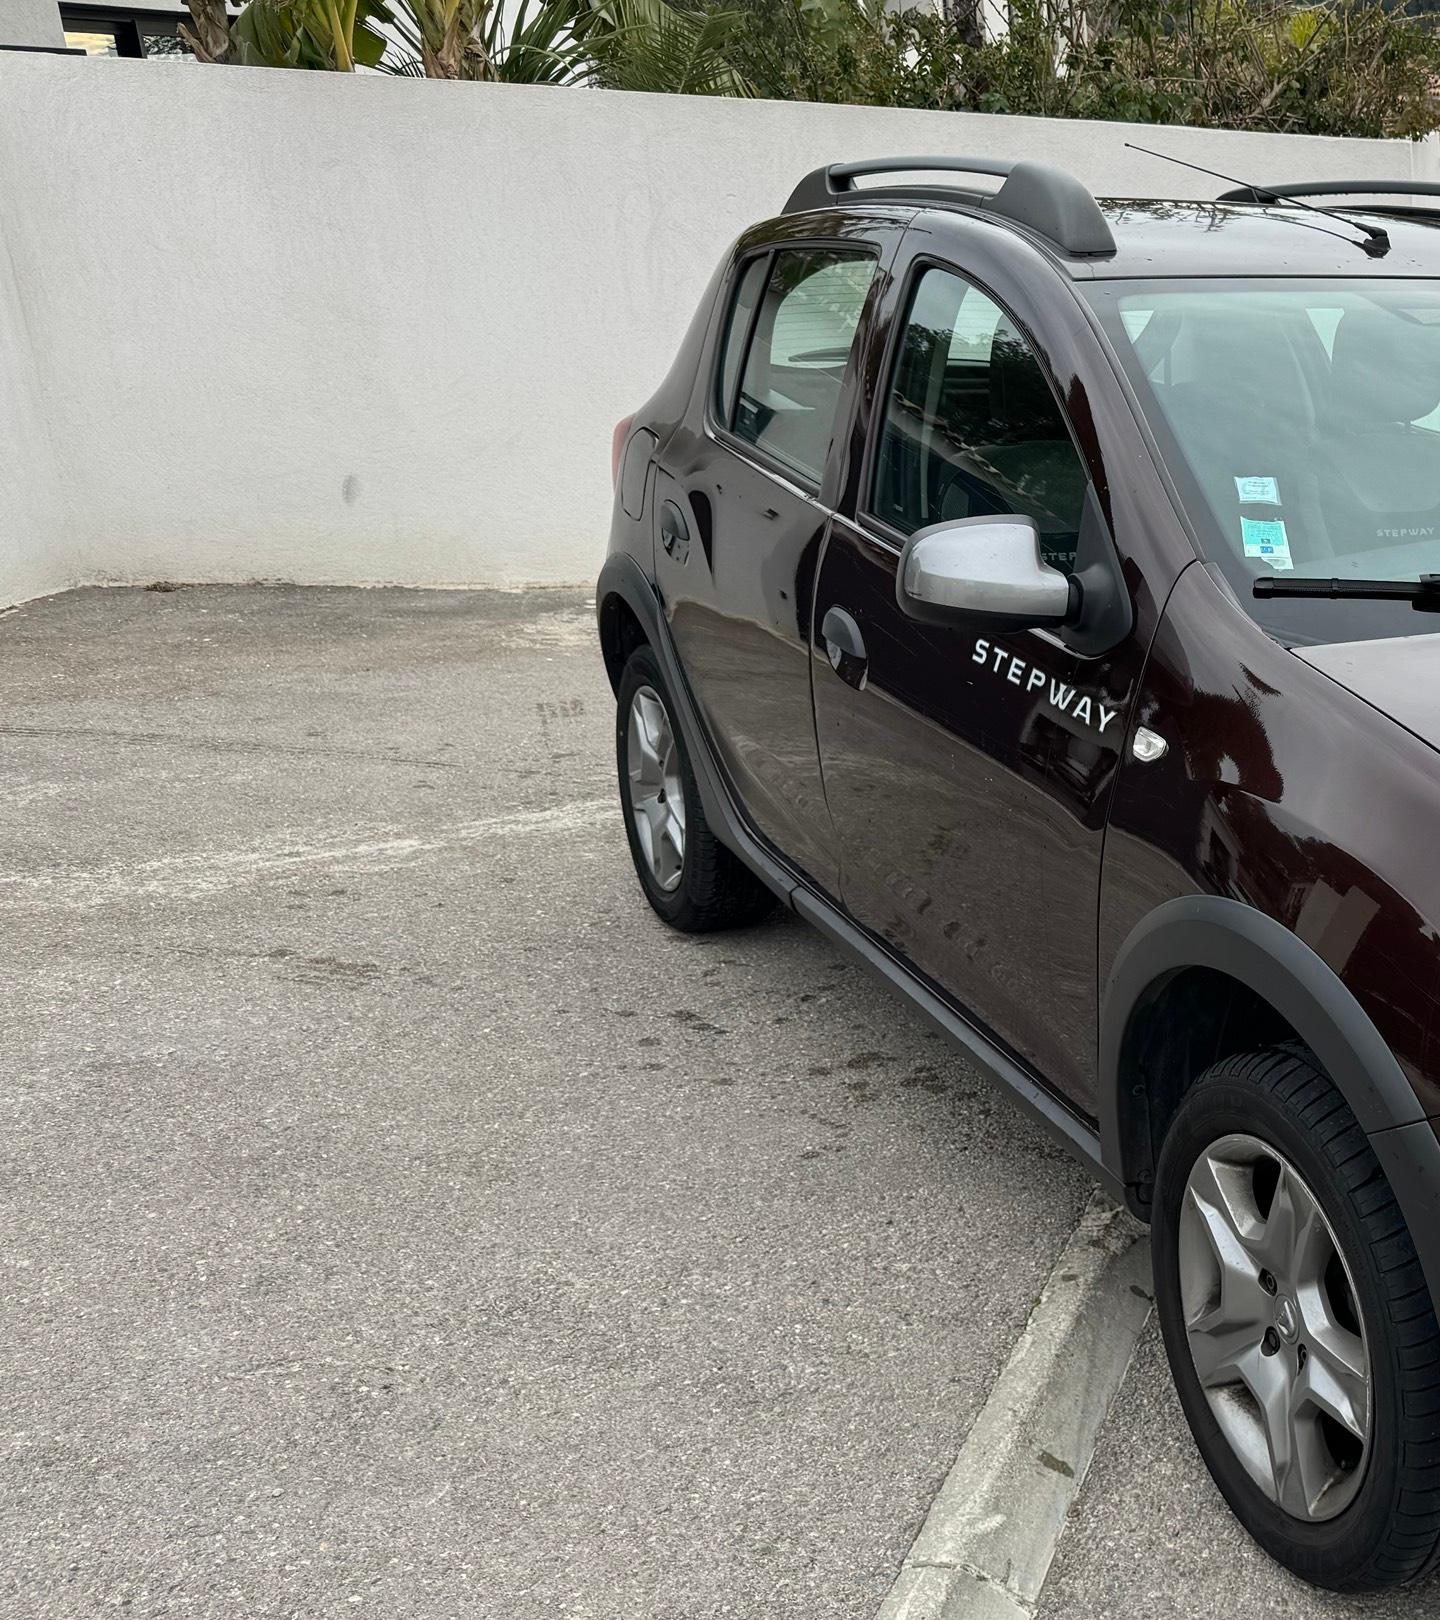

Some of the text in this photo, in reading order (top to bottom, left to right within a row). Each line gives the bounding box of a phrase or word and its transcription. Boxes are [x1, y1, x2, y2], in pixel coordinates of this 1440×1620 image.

[1376, 527, 1435, 537] STEPWAY
[1041, 551, 1077, 561] STEP
[972, 638, 1118, 733] STEPWAY
